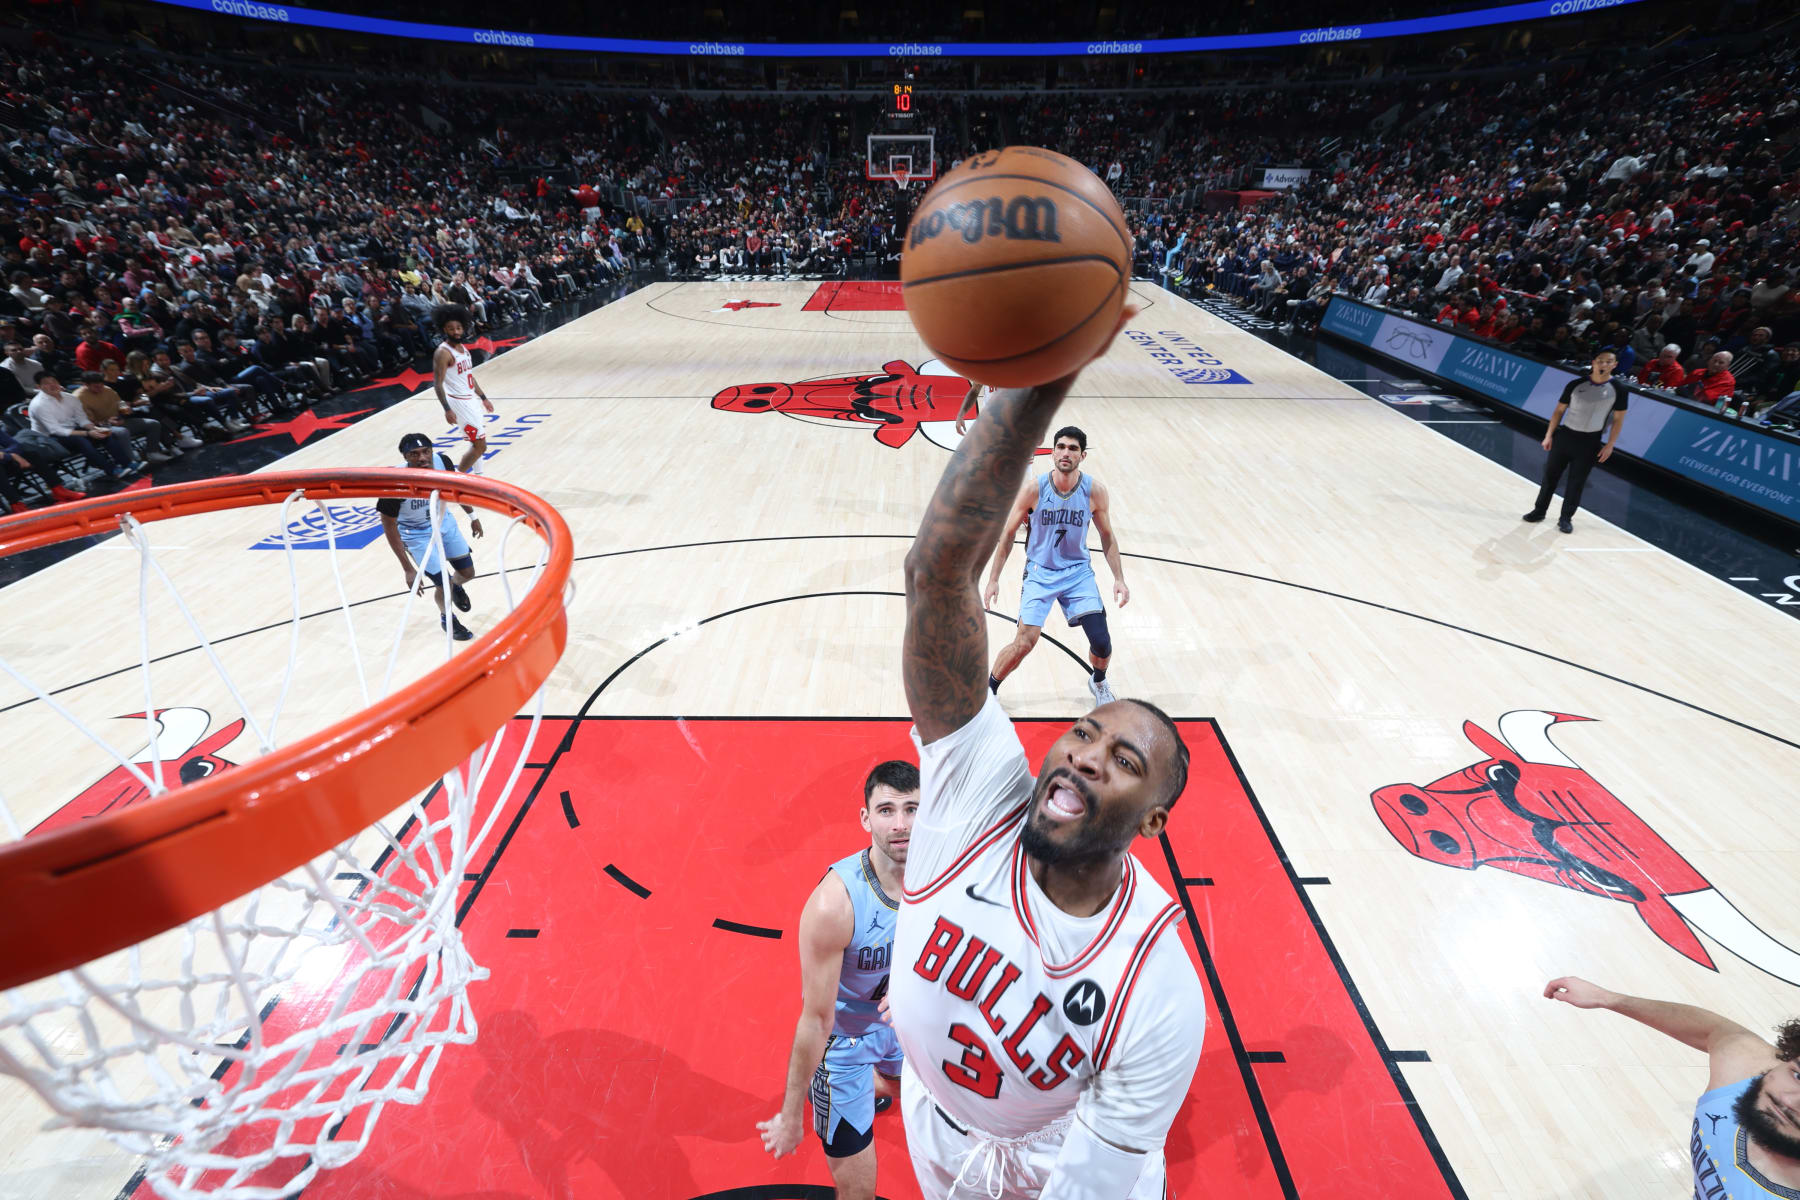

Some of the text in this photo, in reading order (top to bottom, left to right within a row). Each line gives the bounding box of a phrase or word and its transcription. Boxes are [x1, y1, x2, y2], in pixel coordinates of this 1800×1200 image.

[212, 0, 289, 22] coinbase
[1550, 0, 1625, 16] coinba
[473, 29, 535, 47] coinbase
[1299, 27, 1361, 43] coinbase
[689, 41, 745, 55] coinbase
[889, 43, 942, 55] coinbase
[1087, 41, 1142, 54] coinbase
[893, 84, 912, 95] 8:14
[896, 94, 911, 111] 10
[909, 195, 1062, 250] Wilson
[1124, 330, 1184, 365] CENTER
[1157, 330, 1223, 366] UNITED
[1690, 426, 1800, 482] ZENN
[1679, 455, 1794, 505] EYEWEAR FOR EVERYONE
[1041, 508, 1085, 527] GRIZZLIES
[1053, 529, 1068, 549] 7
[913, 915, 1086, 1091] BULLS
[941, 1022, 1004, 1100] 3
